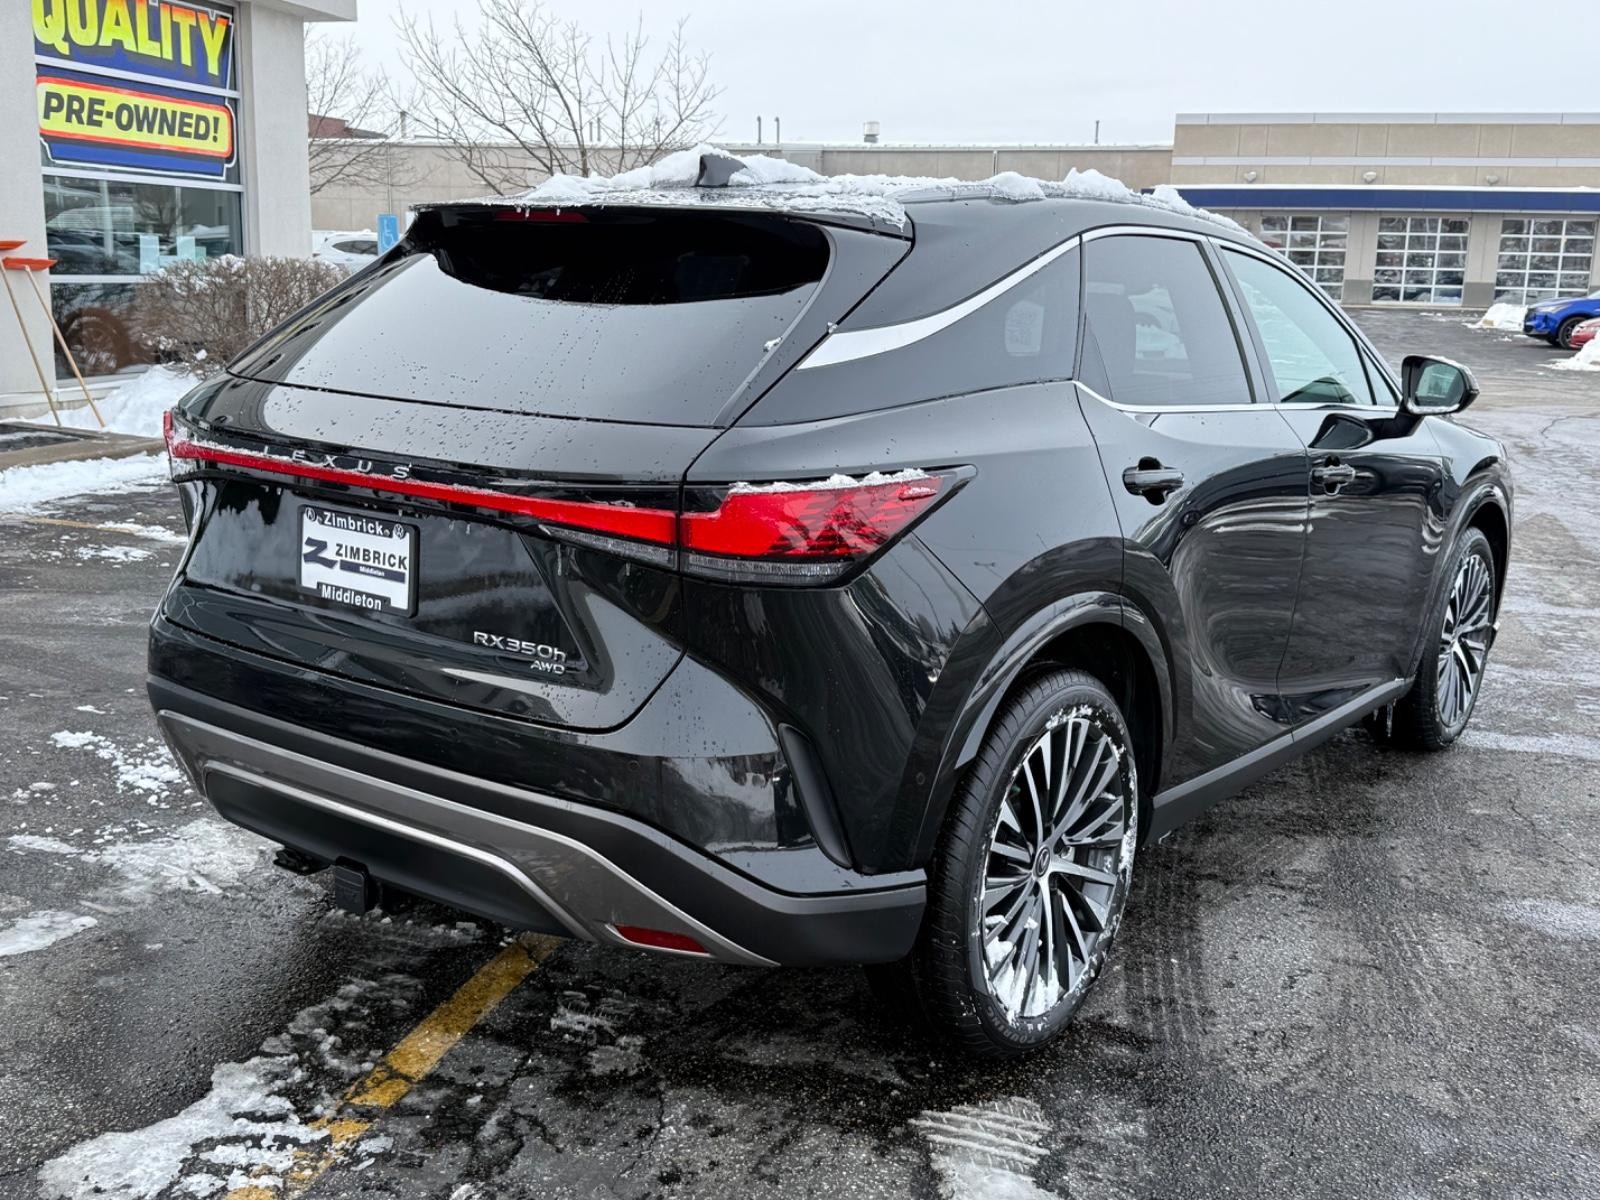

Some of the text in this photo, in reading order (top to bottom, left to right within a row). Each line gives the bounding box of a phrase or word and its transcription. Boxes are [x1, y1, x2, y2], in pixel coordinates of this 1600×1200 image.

[31, 0, 229, 76] QUALITY
[43, 92, 220, 143] PRE-OWNED!
[264, 446, 411, 480] LEXUS
[323, 511, 384, 536] Zimbrick
[335, 543, 408, 570] ZIMBRICK
[321, 584, 382, 611] Middleton
[530, 660, 566, 675] AWD
